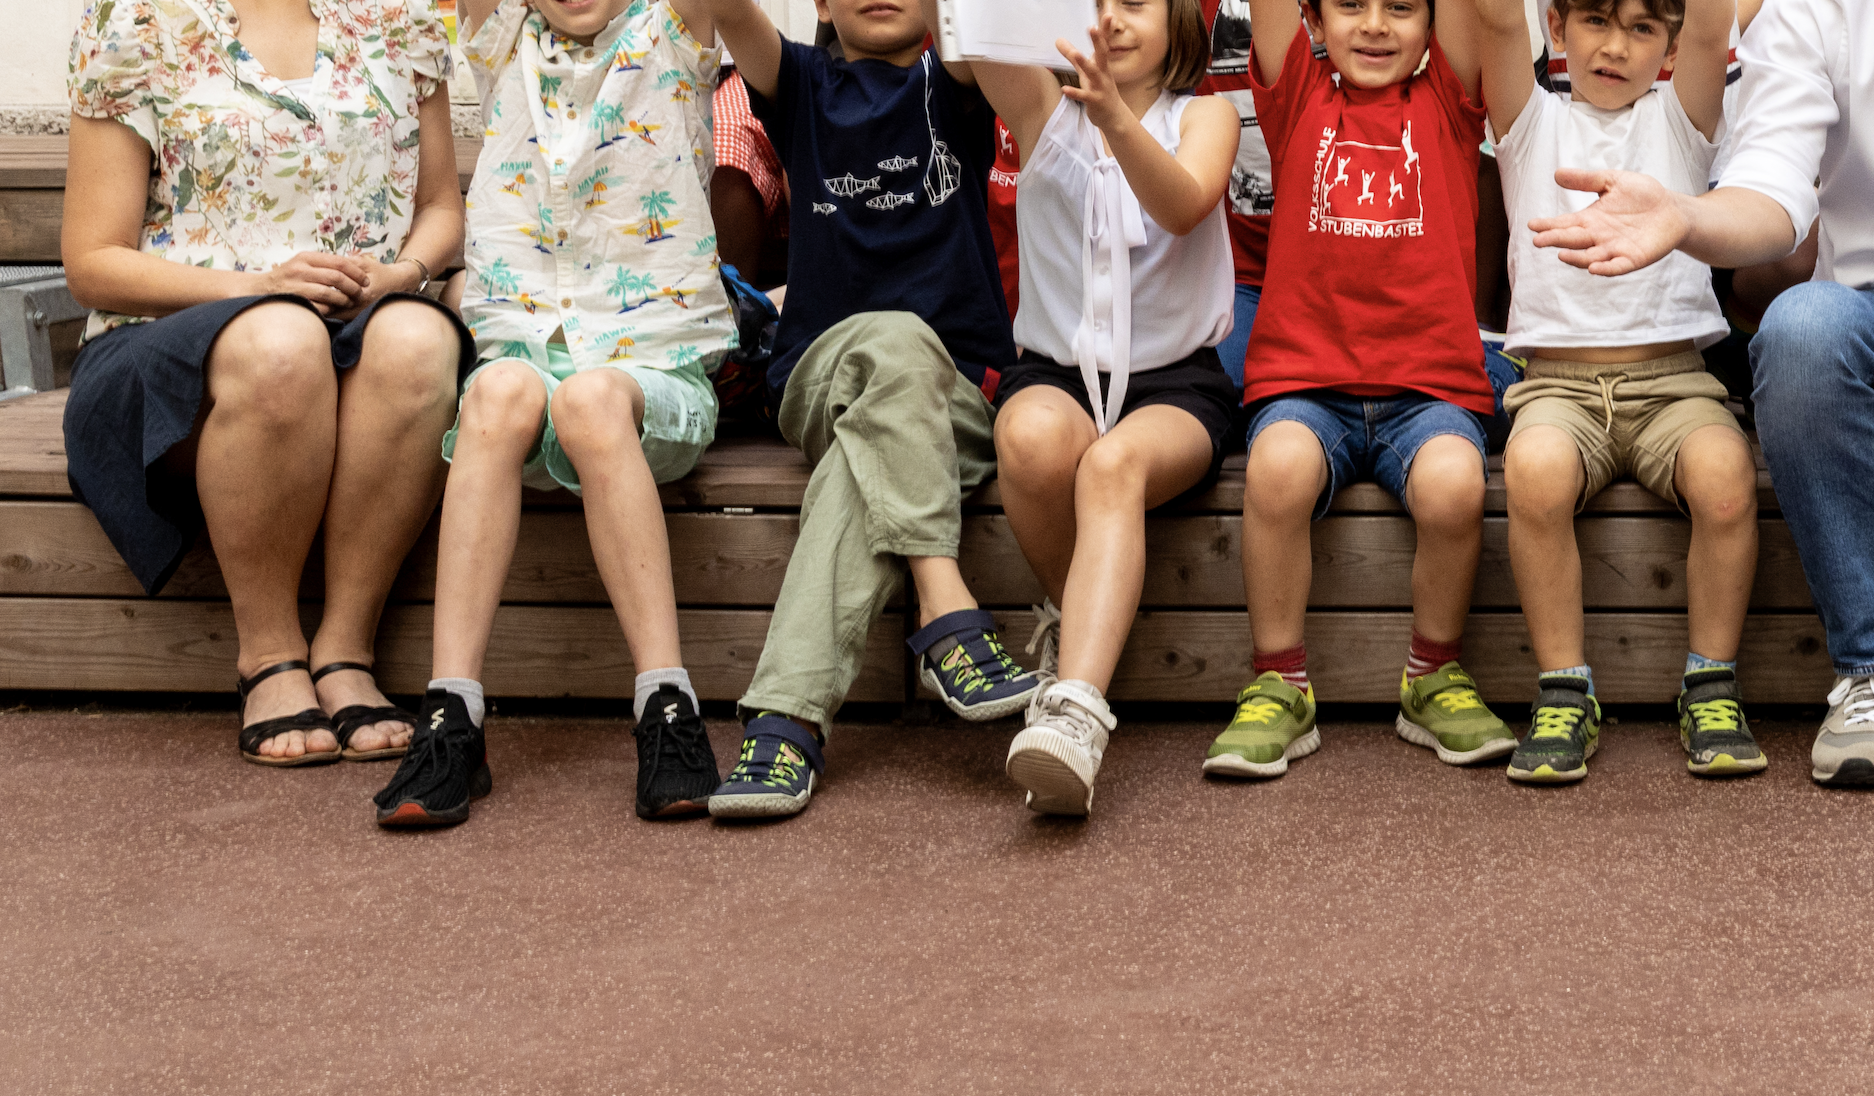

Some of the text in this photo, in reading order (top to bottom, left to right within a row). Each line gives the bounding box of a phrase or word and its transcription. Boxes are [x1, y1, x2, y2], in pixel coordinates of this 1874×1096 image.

[989, 168, 1017, 187] BEN
[1308, 126, 1337, 233] VOLKSSCHULE
[1319, 219, 1425, 239] STUBENBASTEI
